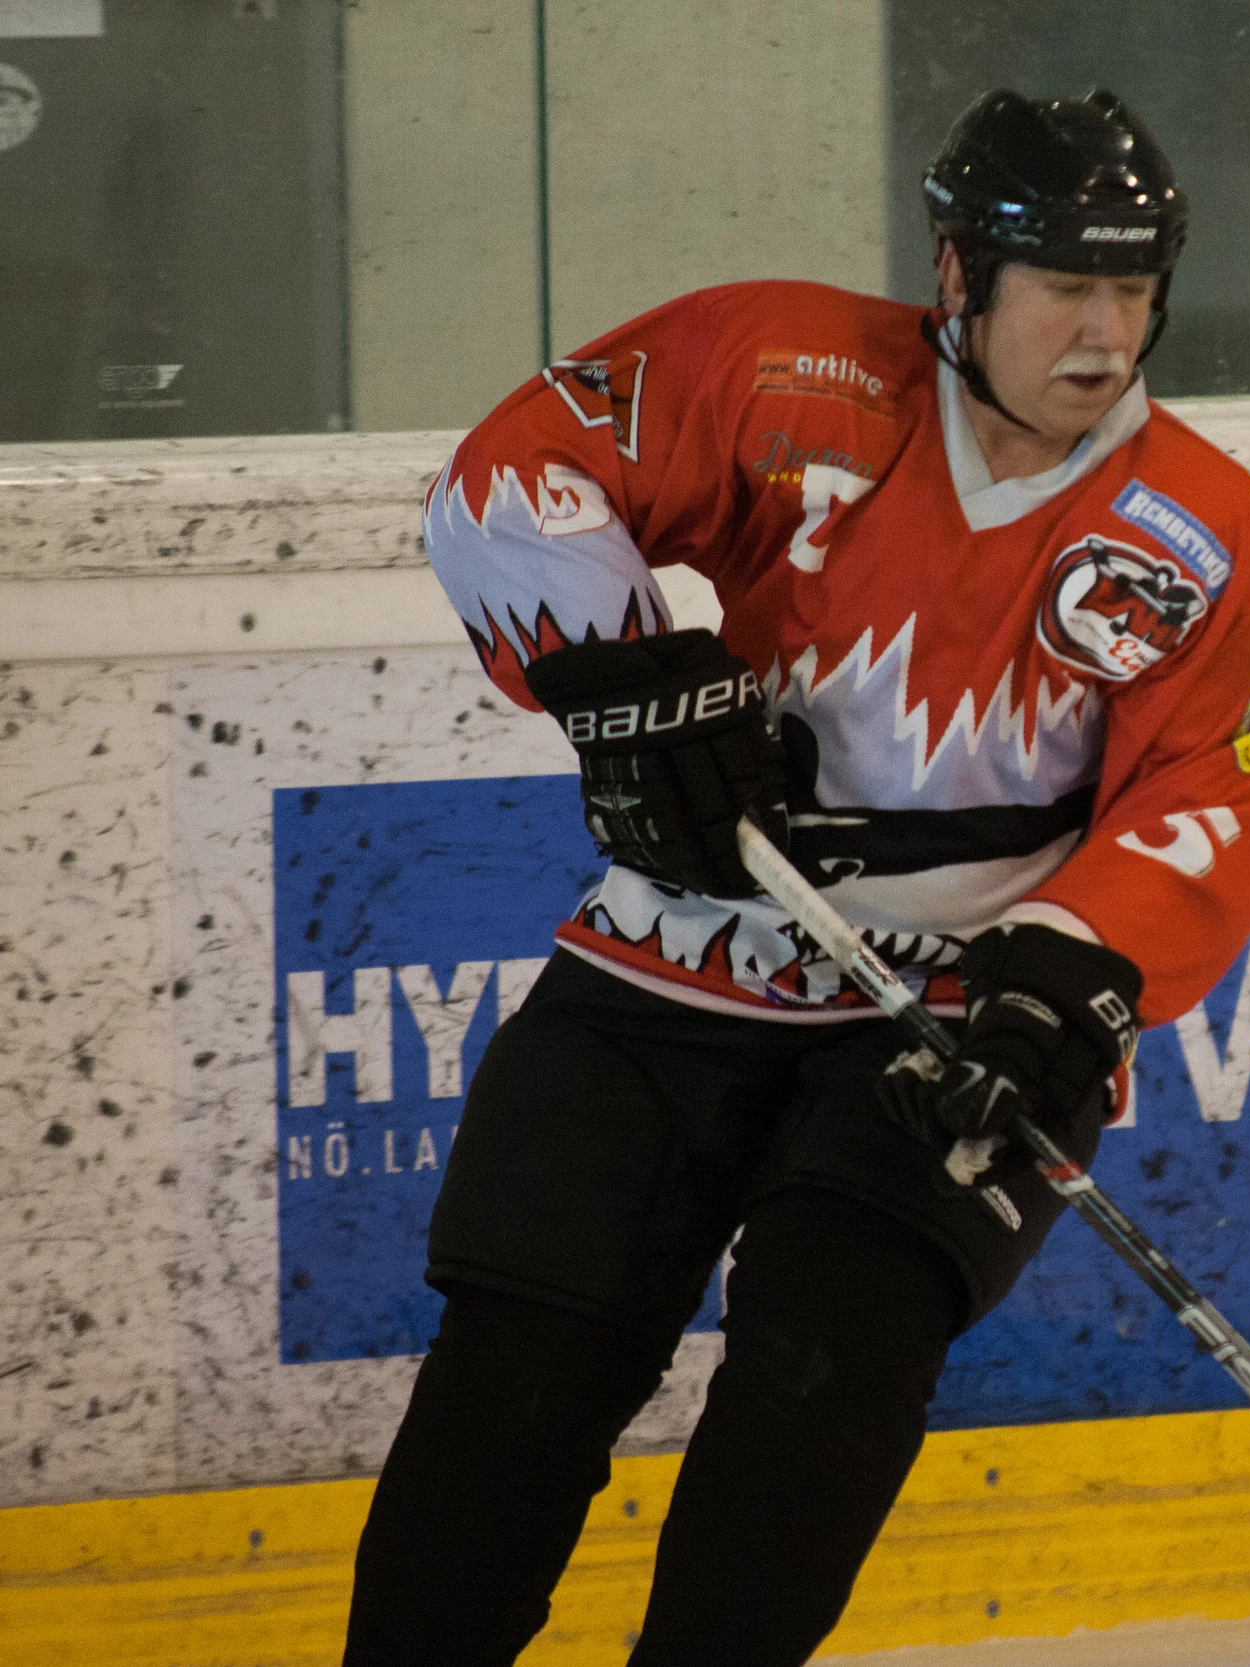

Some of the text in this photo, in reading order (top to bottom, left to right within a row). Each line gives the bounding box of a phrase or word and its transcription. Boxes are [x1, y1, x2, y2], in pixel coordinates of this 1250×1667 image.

[1080, 226, 1158, 243] BAUER
[795, 354, 883, 396] artlive
[1123, 489, 1230, 588] REMBETIKO
[567, 670, 761, 743] BAUER
